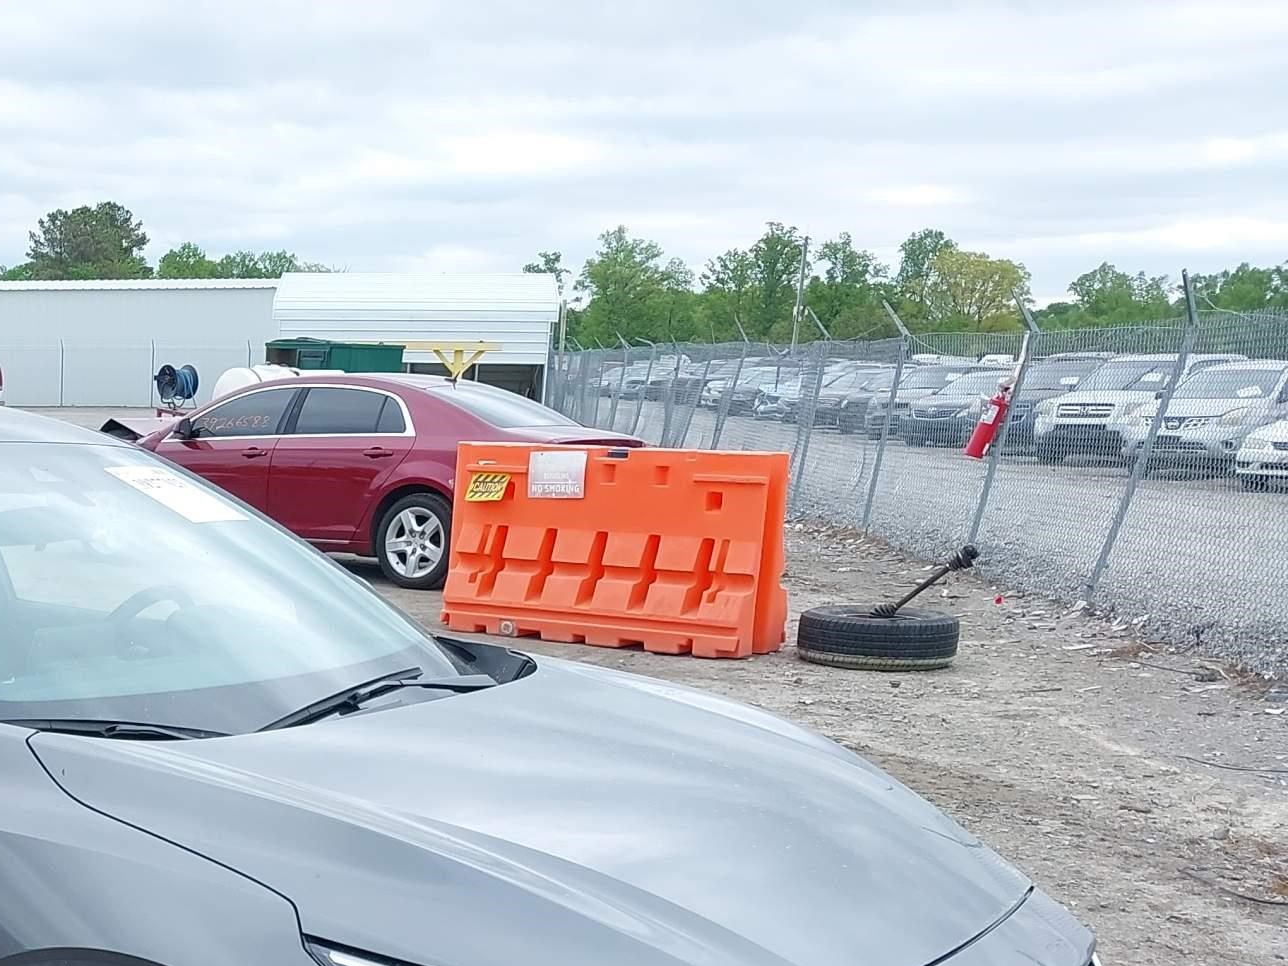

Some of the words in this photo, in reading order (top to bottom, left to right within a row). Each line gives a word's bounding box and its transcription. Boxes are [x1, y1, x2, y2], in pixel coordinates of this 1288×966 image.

[472, 482, 503, 493] CAUTION
[531, 484, 543, 493] NO
[545, 484, 580, 493] SMOKING
